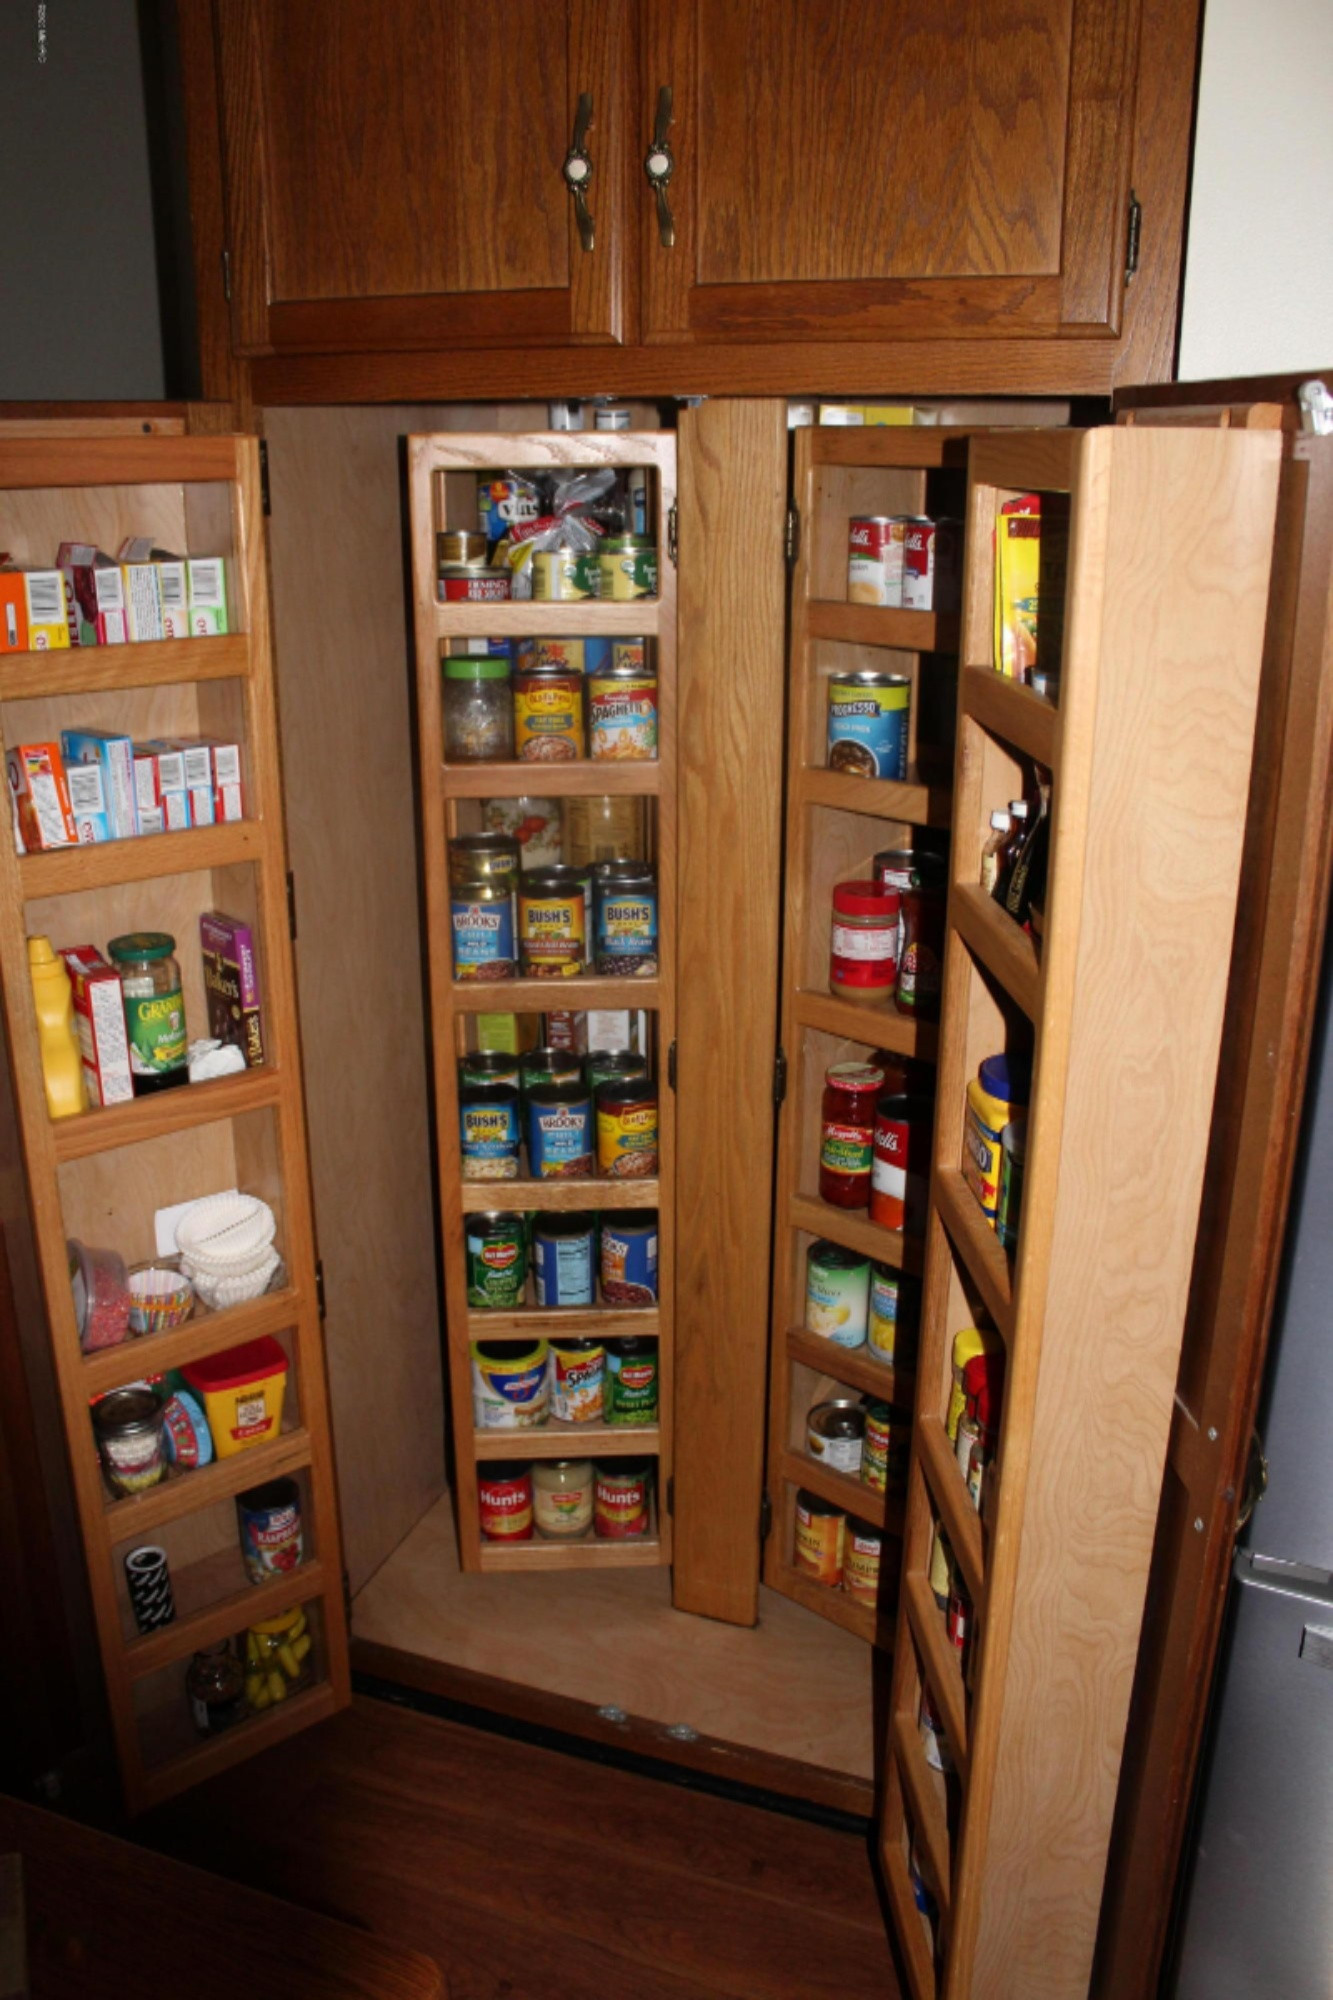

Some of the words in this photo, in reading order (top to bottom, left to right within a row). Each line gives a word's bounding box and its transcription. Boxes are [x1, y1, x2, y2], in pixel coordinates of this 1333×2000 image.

[528, 908, 570, 923] BUSH'S
[607, 906, 649, 920] BUSH'S
[456, 916, 497, 928] BROOKS
[466, 1113, 508, 1129] BUSH'S
[480, 1489, 526, 1507] Hunt's
[597, 1484, 641, 1506] Hunt's
